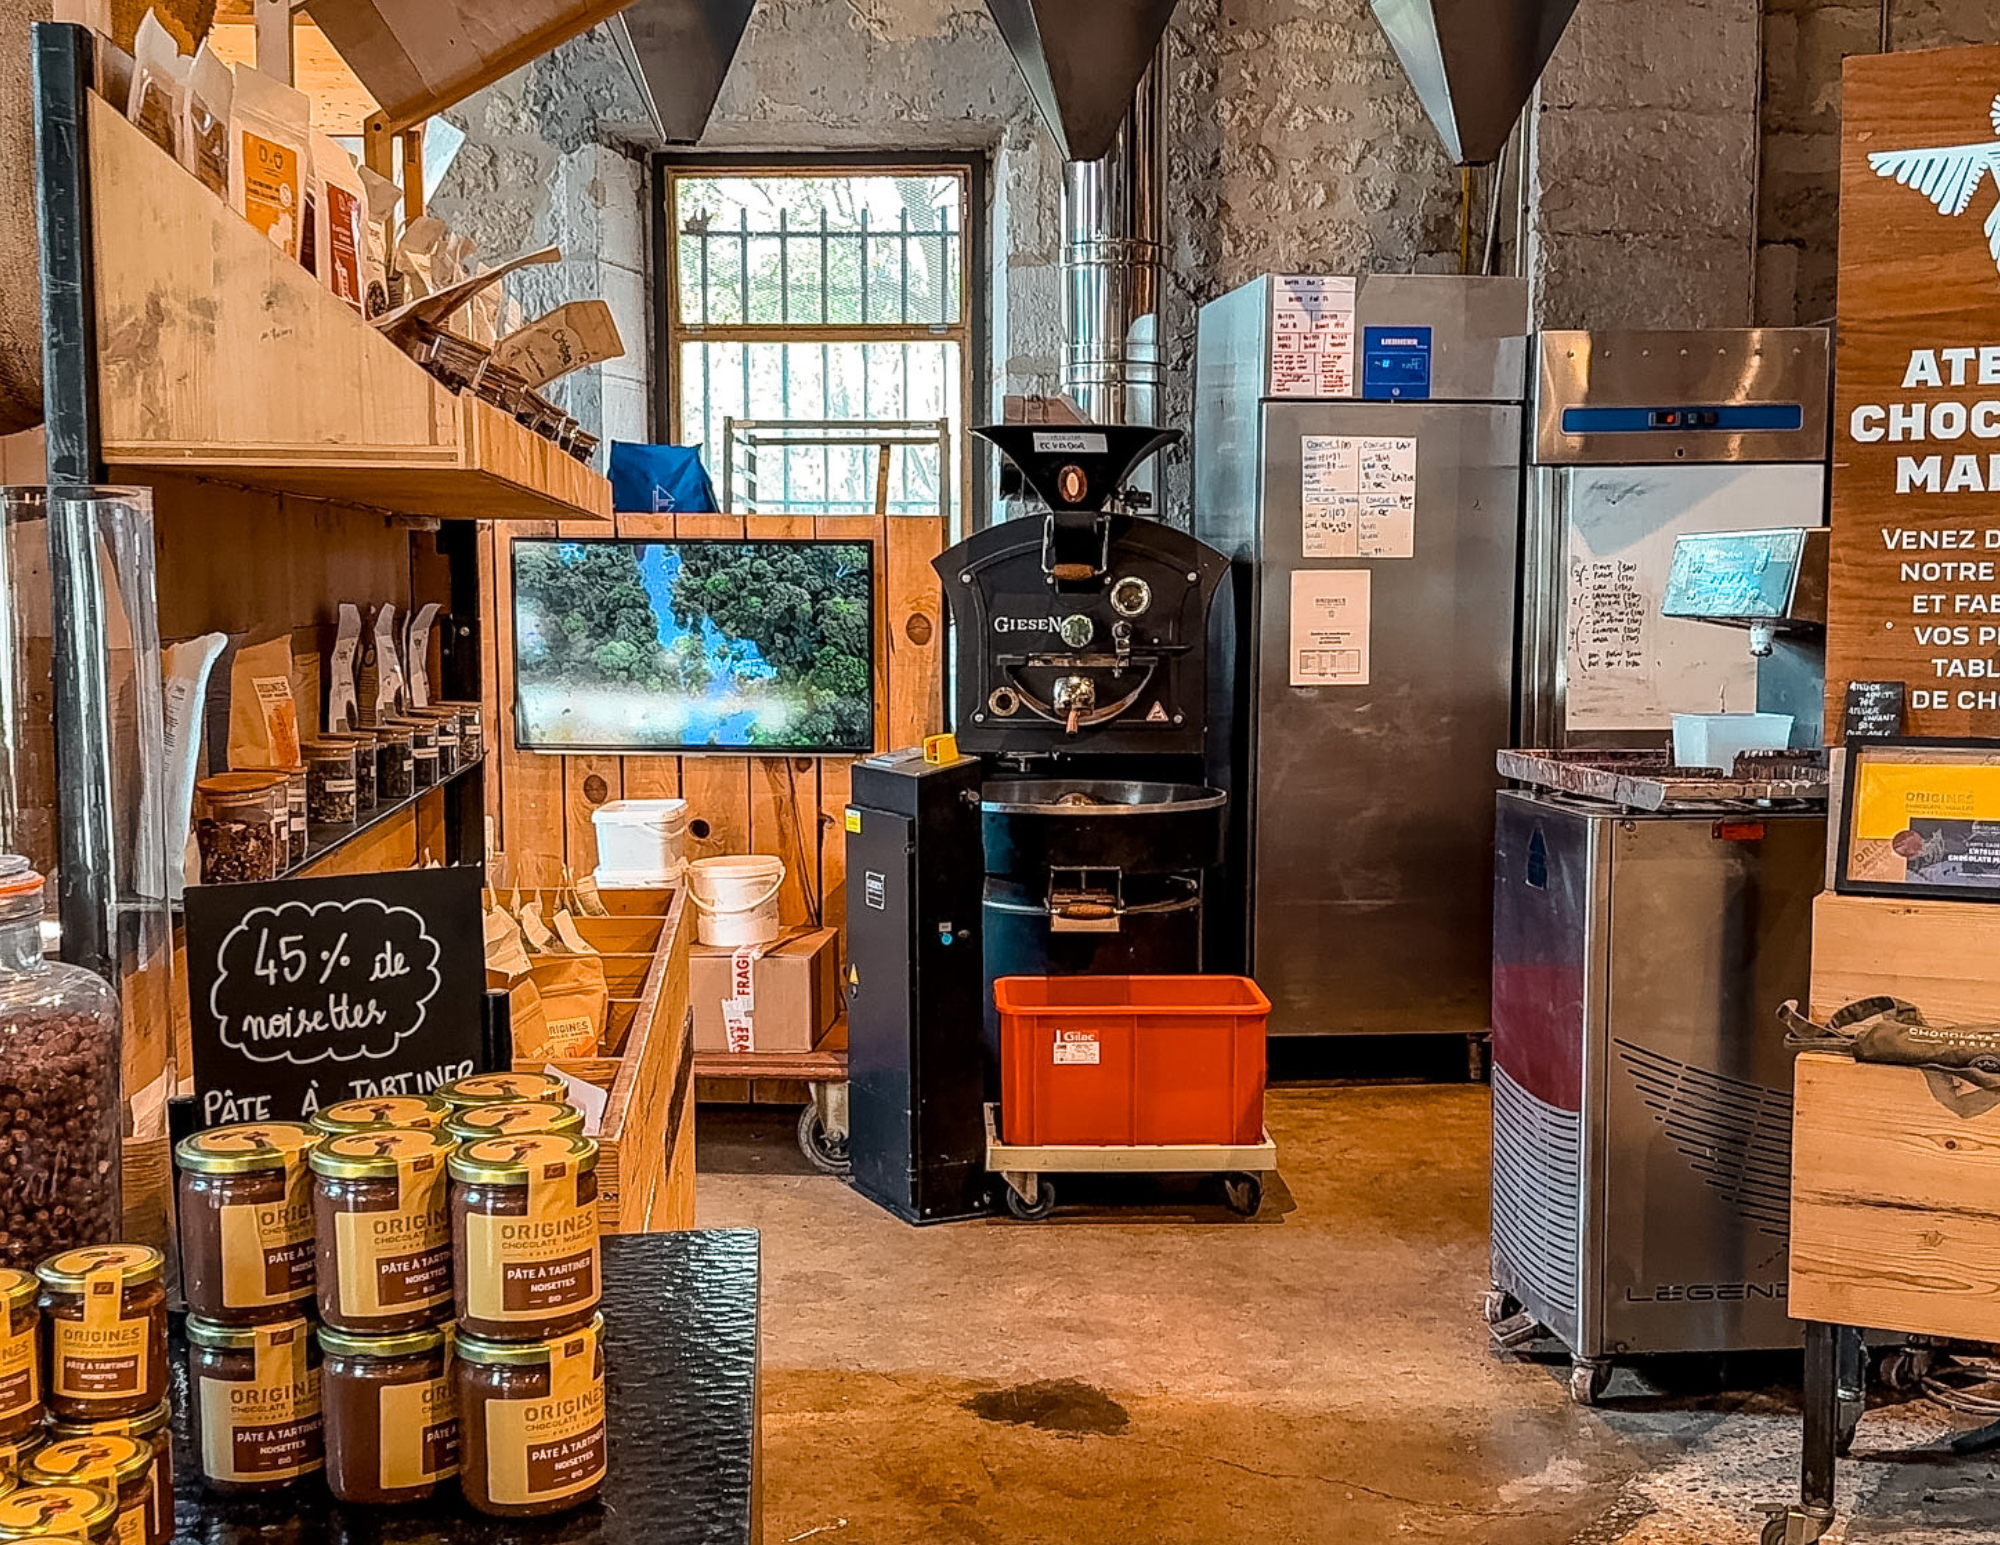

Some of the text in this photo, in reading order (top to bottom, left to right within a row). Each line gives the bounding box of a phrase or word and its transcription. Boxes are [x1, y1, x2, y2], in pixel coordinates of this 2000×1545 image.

[1850, 400, 2000, 442] CHOC
[1895, 453, 2000, 494] MA
[1881, 528, 1976, 550] VENEZ
[1900, 562, 1995, 582] NOTRE
[1912, 594, 1947, 614] ET
[1913, 626, 2000, 646] VOS P
[1911, 690, 2000, 711] DE CH
[254, 927, 411, 986] 45 % de
[241, 992, 388, 1042] noisettes
[203, 1089, 272, 1126] PÂTE
[301, 1079, 320, 1117] À
[501, 1210, 593, 1240] ORIGINES
[269, 1251, 295, 1265] PÂTE
[381, 1261, 411, 1275] PÂTE
[507, 1266, 536, 1280] PÂTE
[547, 1255, 591, 1277] TARTINER
[530, 1275, 577, 1293] NOISETTES
[63, 1327, 140, 1342] ORIGINES
[237, 1431, 264, 1443] PÂTE
[260, 1439, 307, 1455] NOISETTES
[531, 1447, 560, 1461] PÂTE
[554, 1449, 595, 1471] NOISETTES
